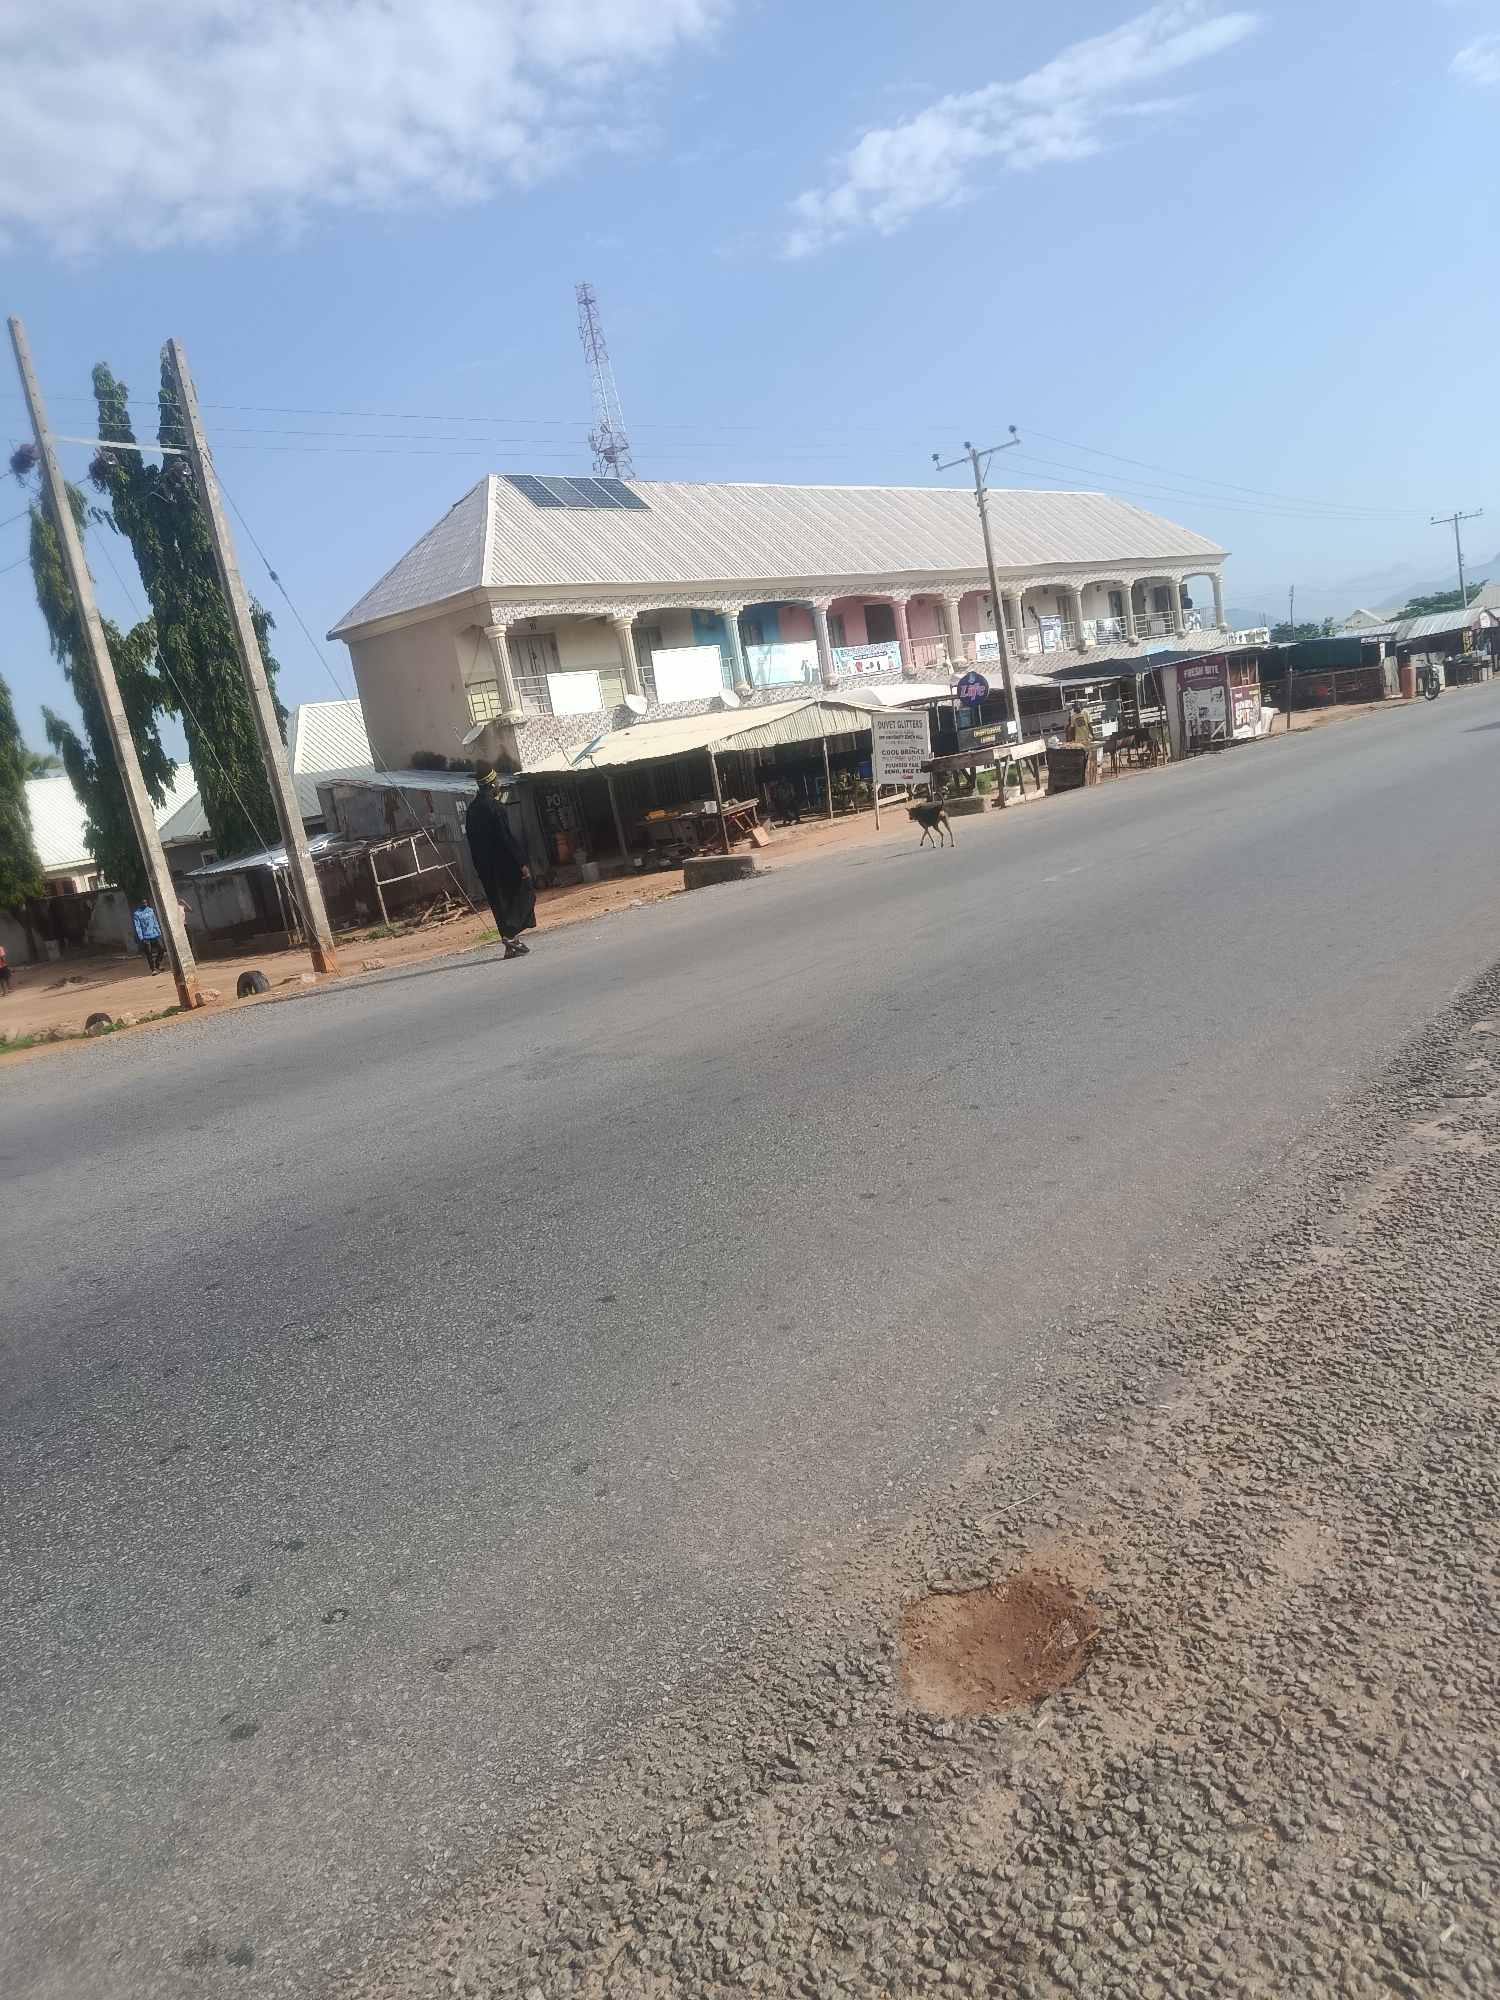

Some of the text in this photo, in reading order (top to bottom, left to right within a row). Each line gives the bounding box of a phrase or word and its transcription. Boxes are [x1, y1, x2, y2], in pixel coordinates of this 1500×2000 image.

[1184, 665, 1219, 678] FRESH BITE
[960, 682, 985, 701] Life
[878, 720, 922, 729] DUVET GLITTERS
